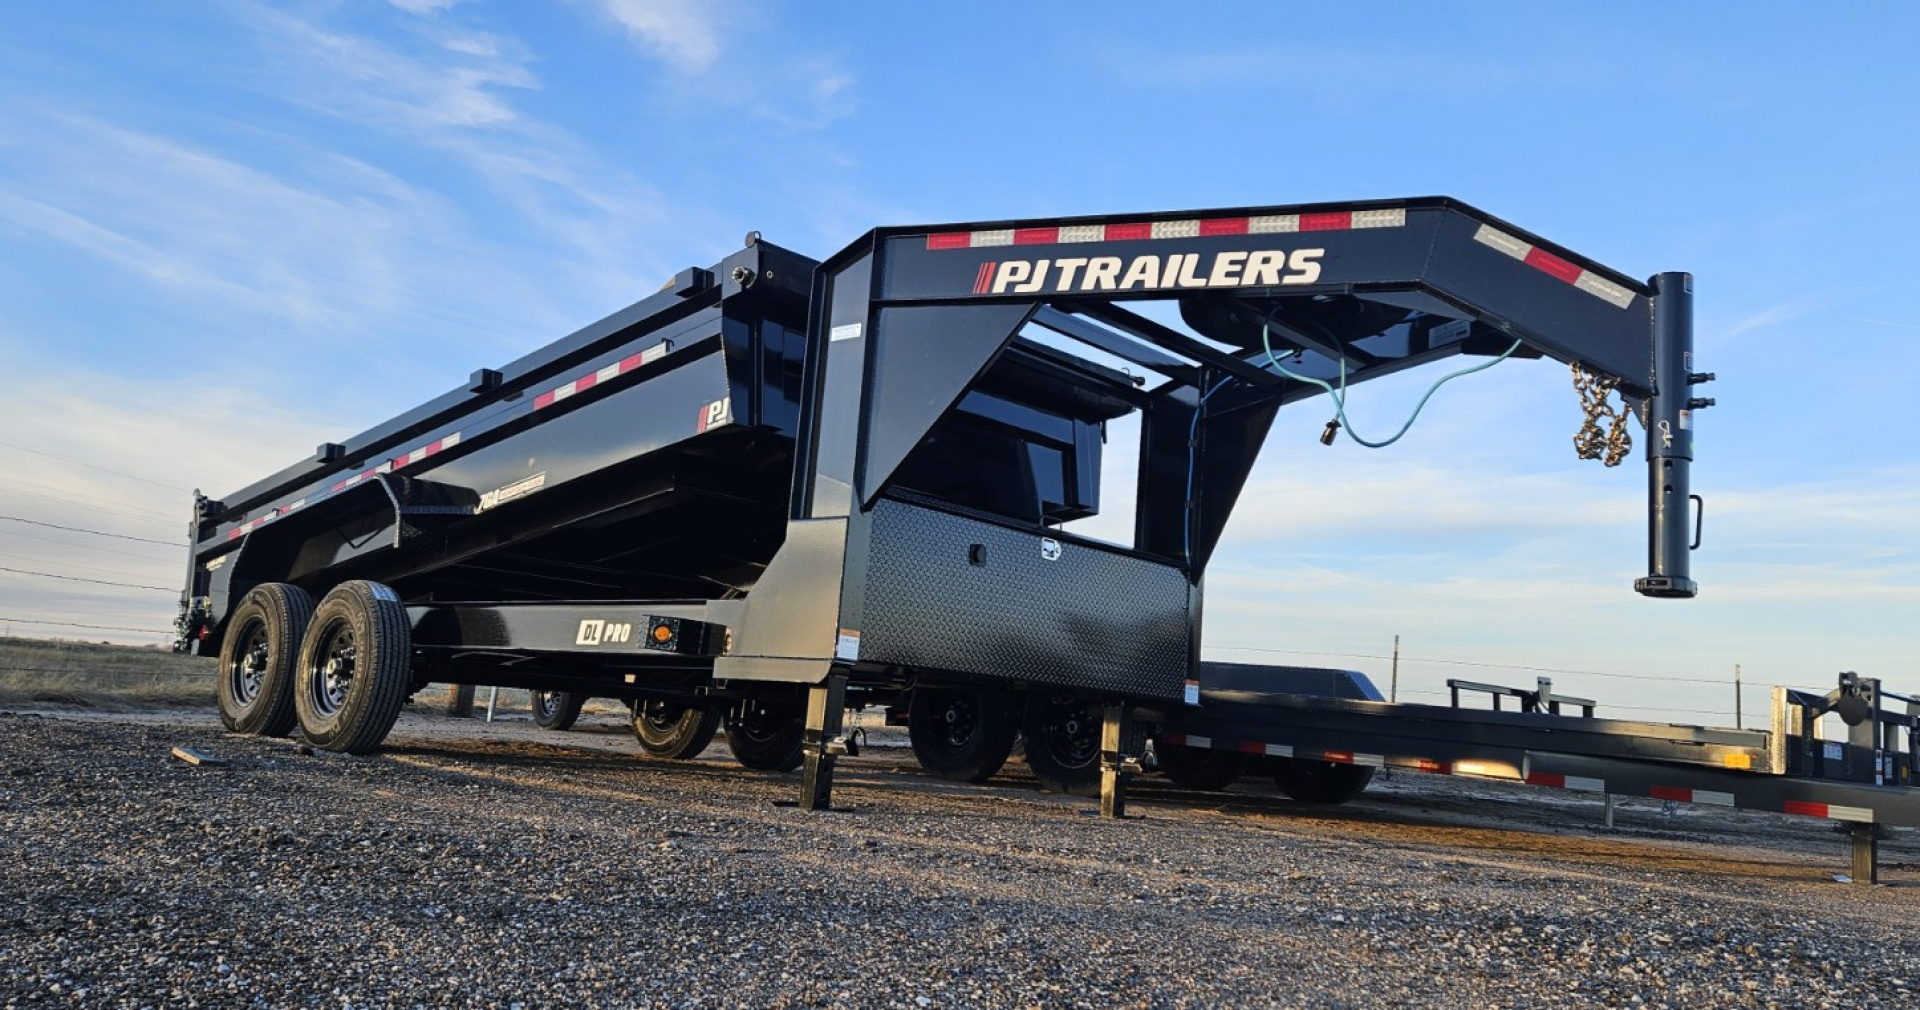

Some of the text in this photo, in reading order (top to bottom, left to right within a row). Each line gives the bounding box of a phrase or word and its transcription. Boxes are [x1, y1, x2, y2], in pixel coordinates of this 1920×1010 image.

[992, 248, 1325, 293] PJ TRAILERS
[707, 397, 729, 423] PJ
[603, 623, 631, 642] PRO
